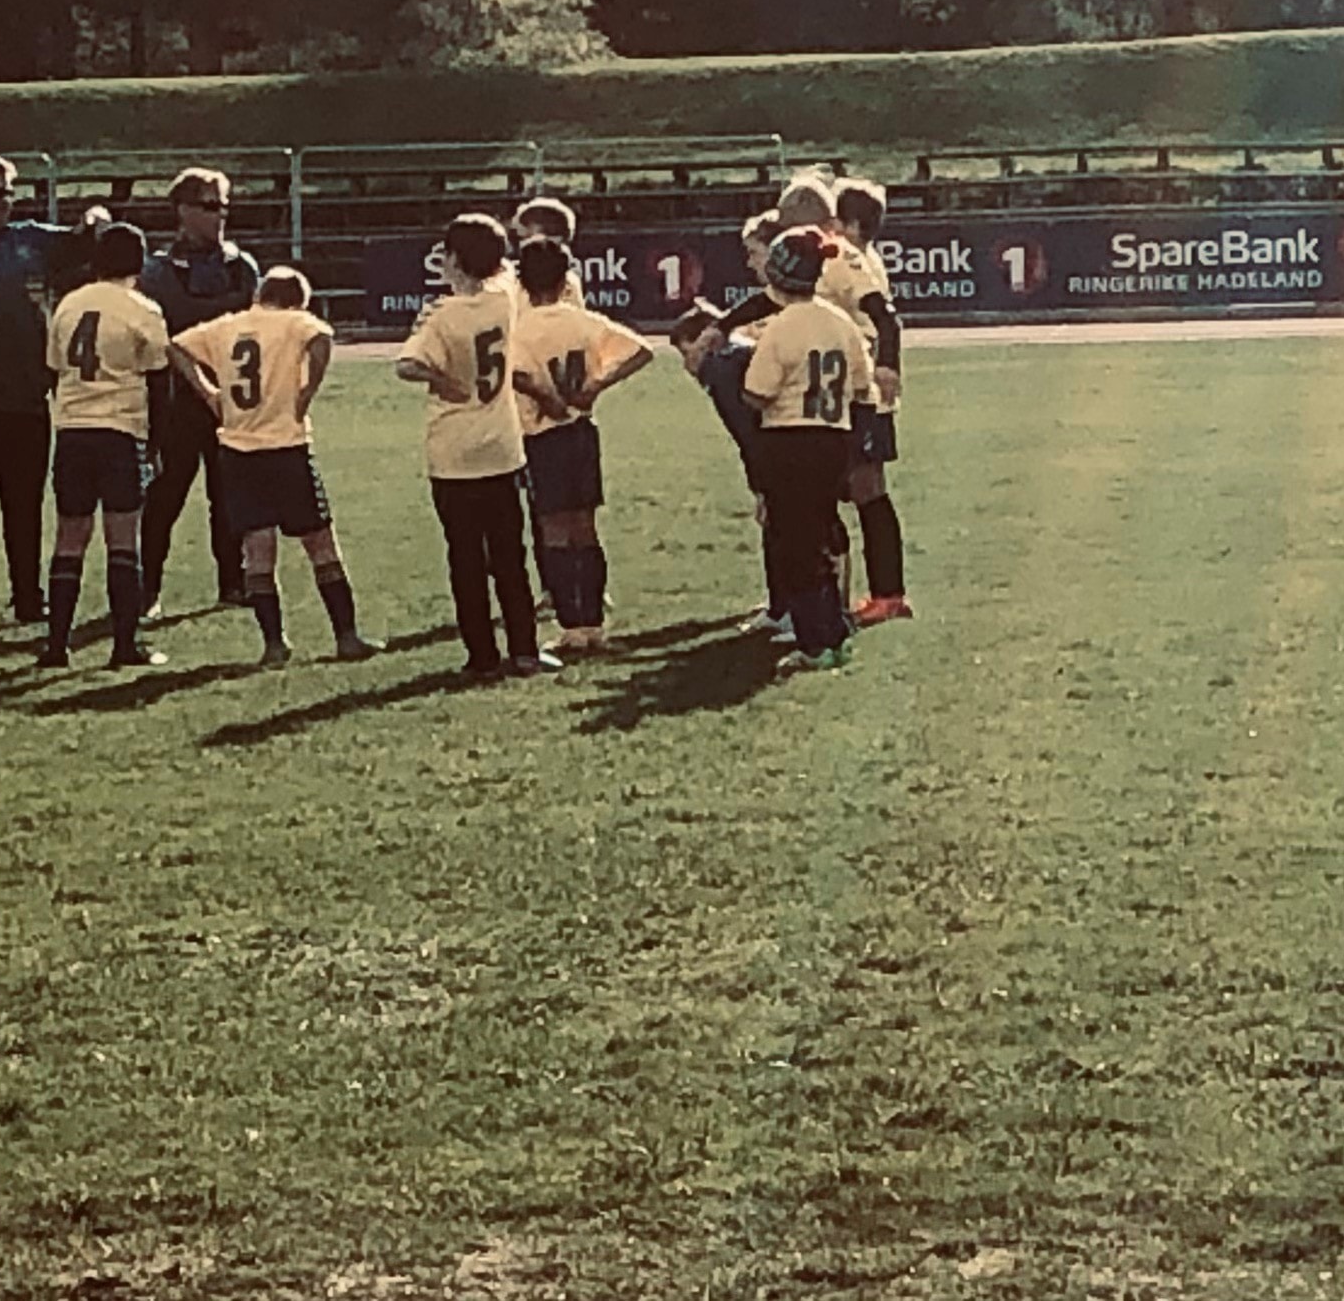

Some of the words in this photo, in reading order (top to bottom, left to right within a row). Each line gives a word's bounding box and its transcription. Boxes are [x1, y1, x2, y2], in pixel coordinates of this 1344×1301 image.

[658, 255, 680, 299] 1
[1002, 247, 1026, 291] 1
[1111, 229, 1319, 272] SpareBank
[1069, 274, 1189, 293] RINGERIKE
[1197, 270, 1322, 290] HADELAND
[68, 311, 100, 381] 4
[230, 339, 261, 410] 3
[475, 326, 506, 404] 5
[803, 349, 847, 423] 13
